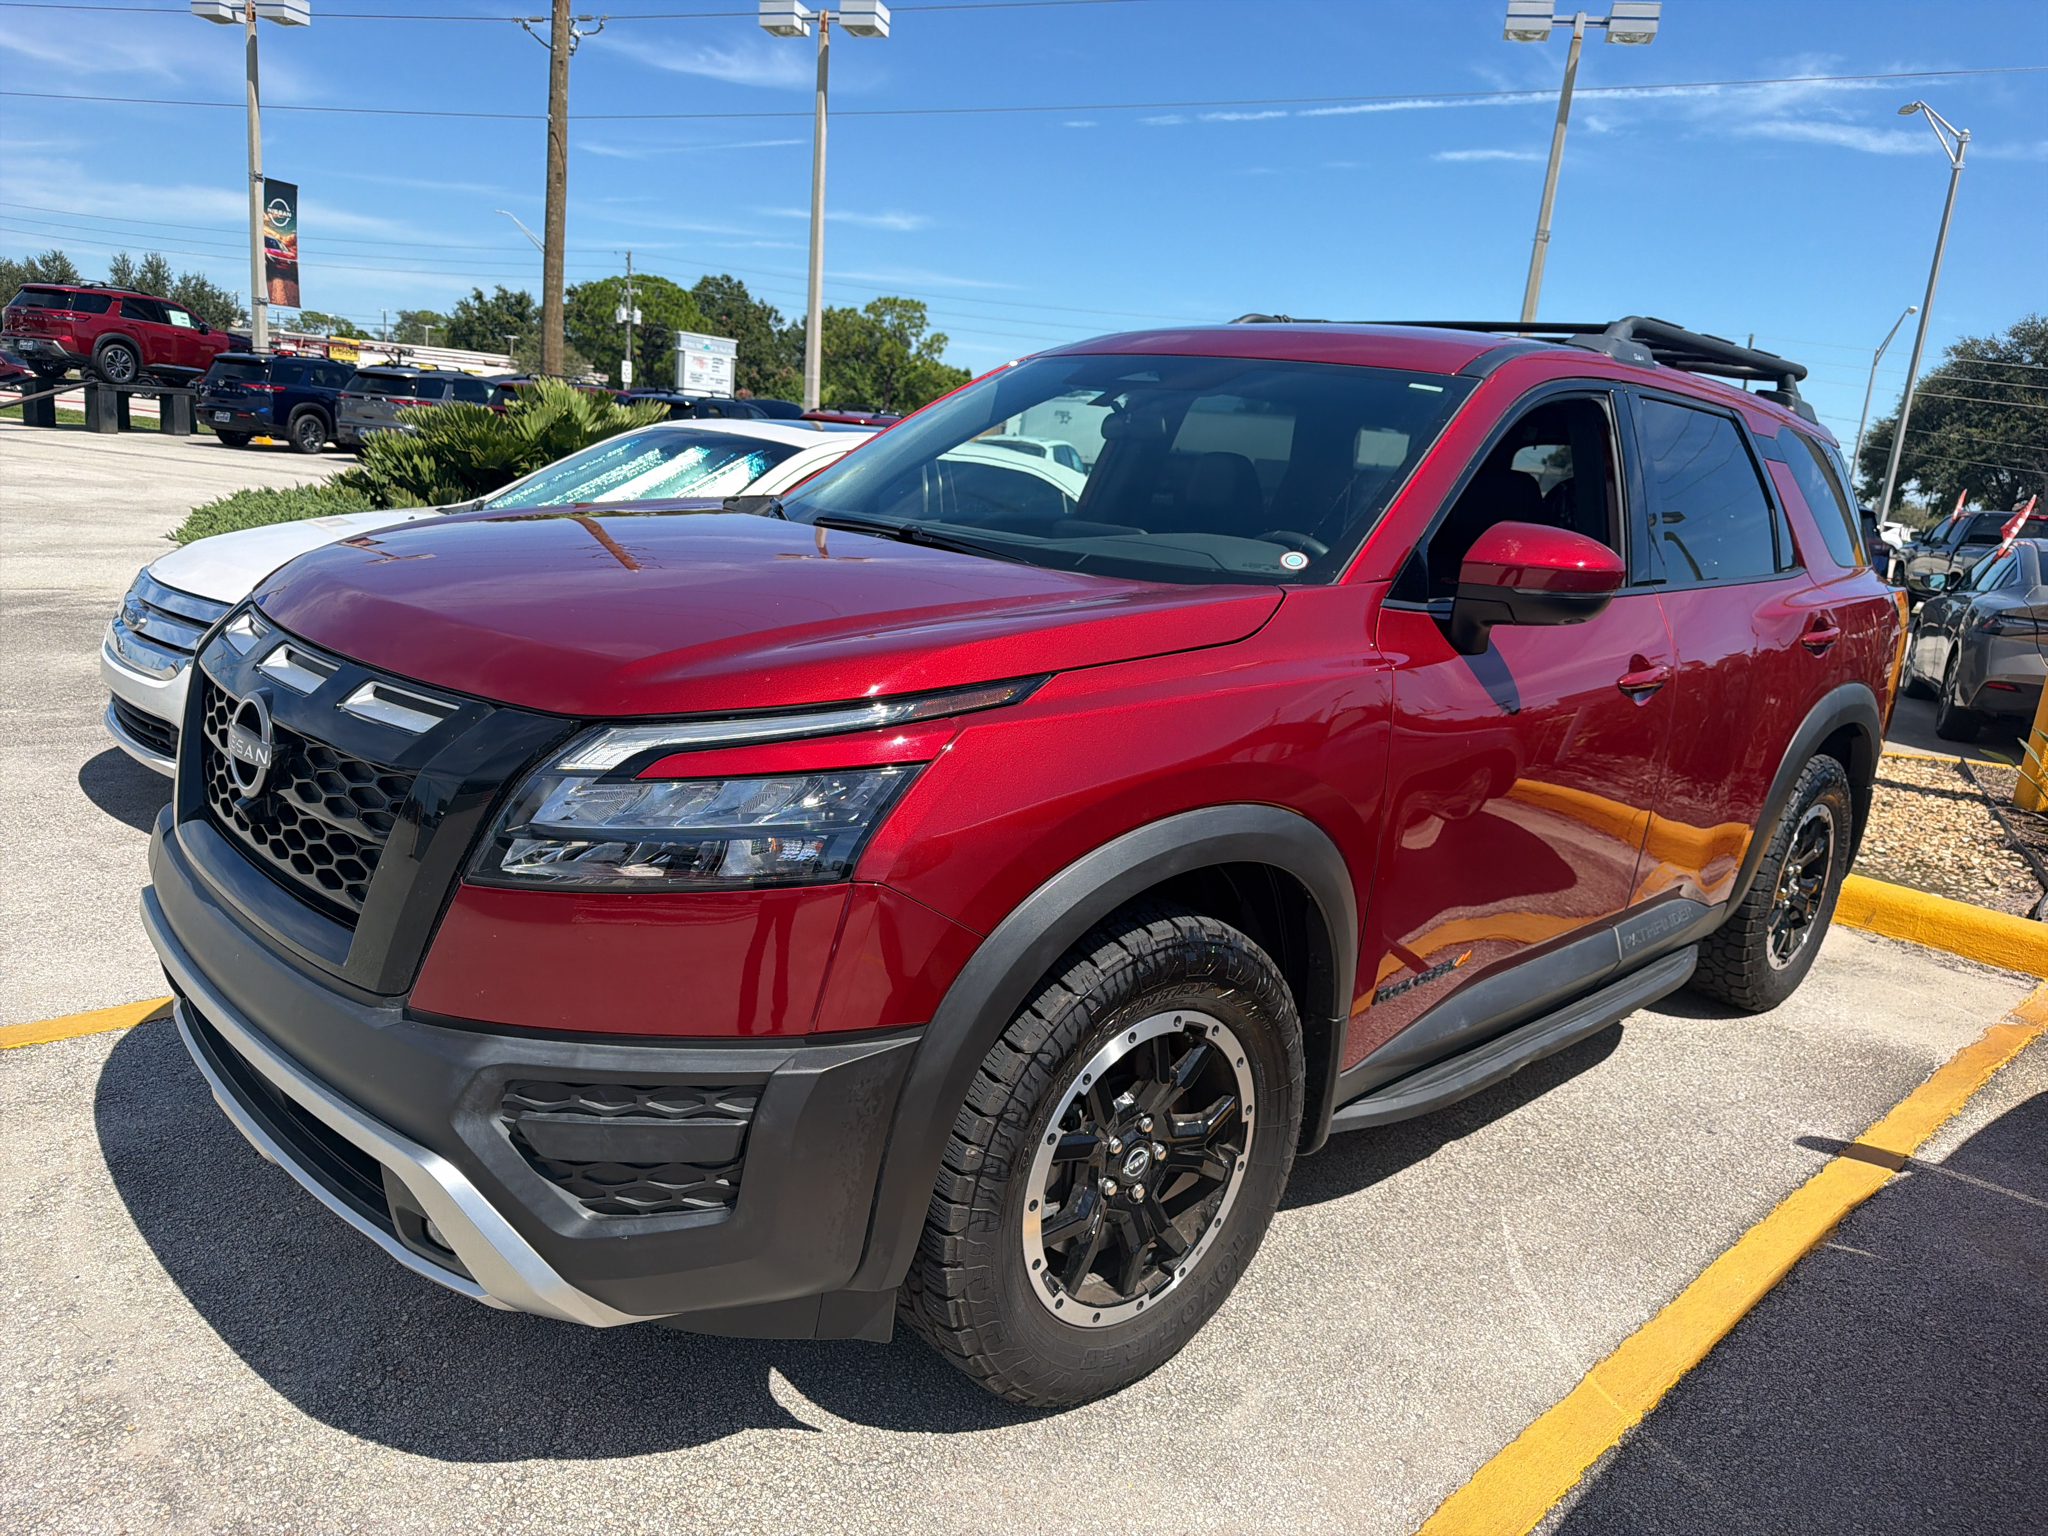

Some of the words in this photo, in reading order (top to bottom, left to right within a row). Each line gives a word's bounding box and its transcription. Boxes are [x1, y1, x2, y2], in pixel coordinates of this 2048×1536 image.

[267, 206, 292, 218] NISSAN
[230, 734, 268, 765] SSAN
[1623, 905, 1695, 950] PATHFINDER
[1180, 1231, 1249, 1329] TOYO
